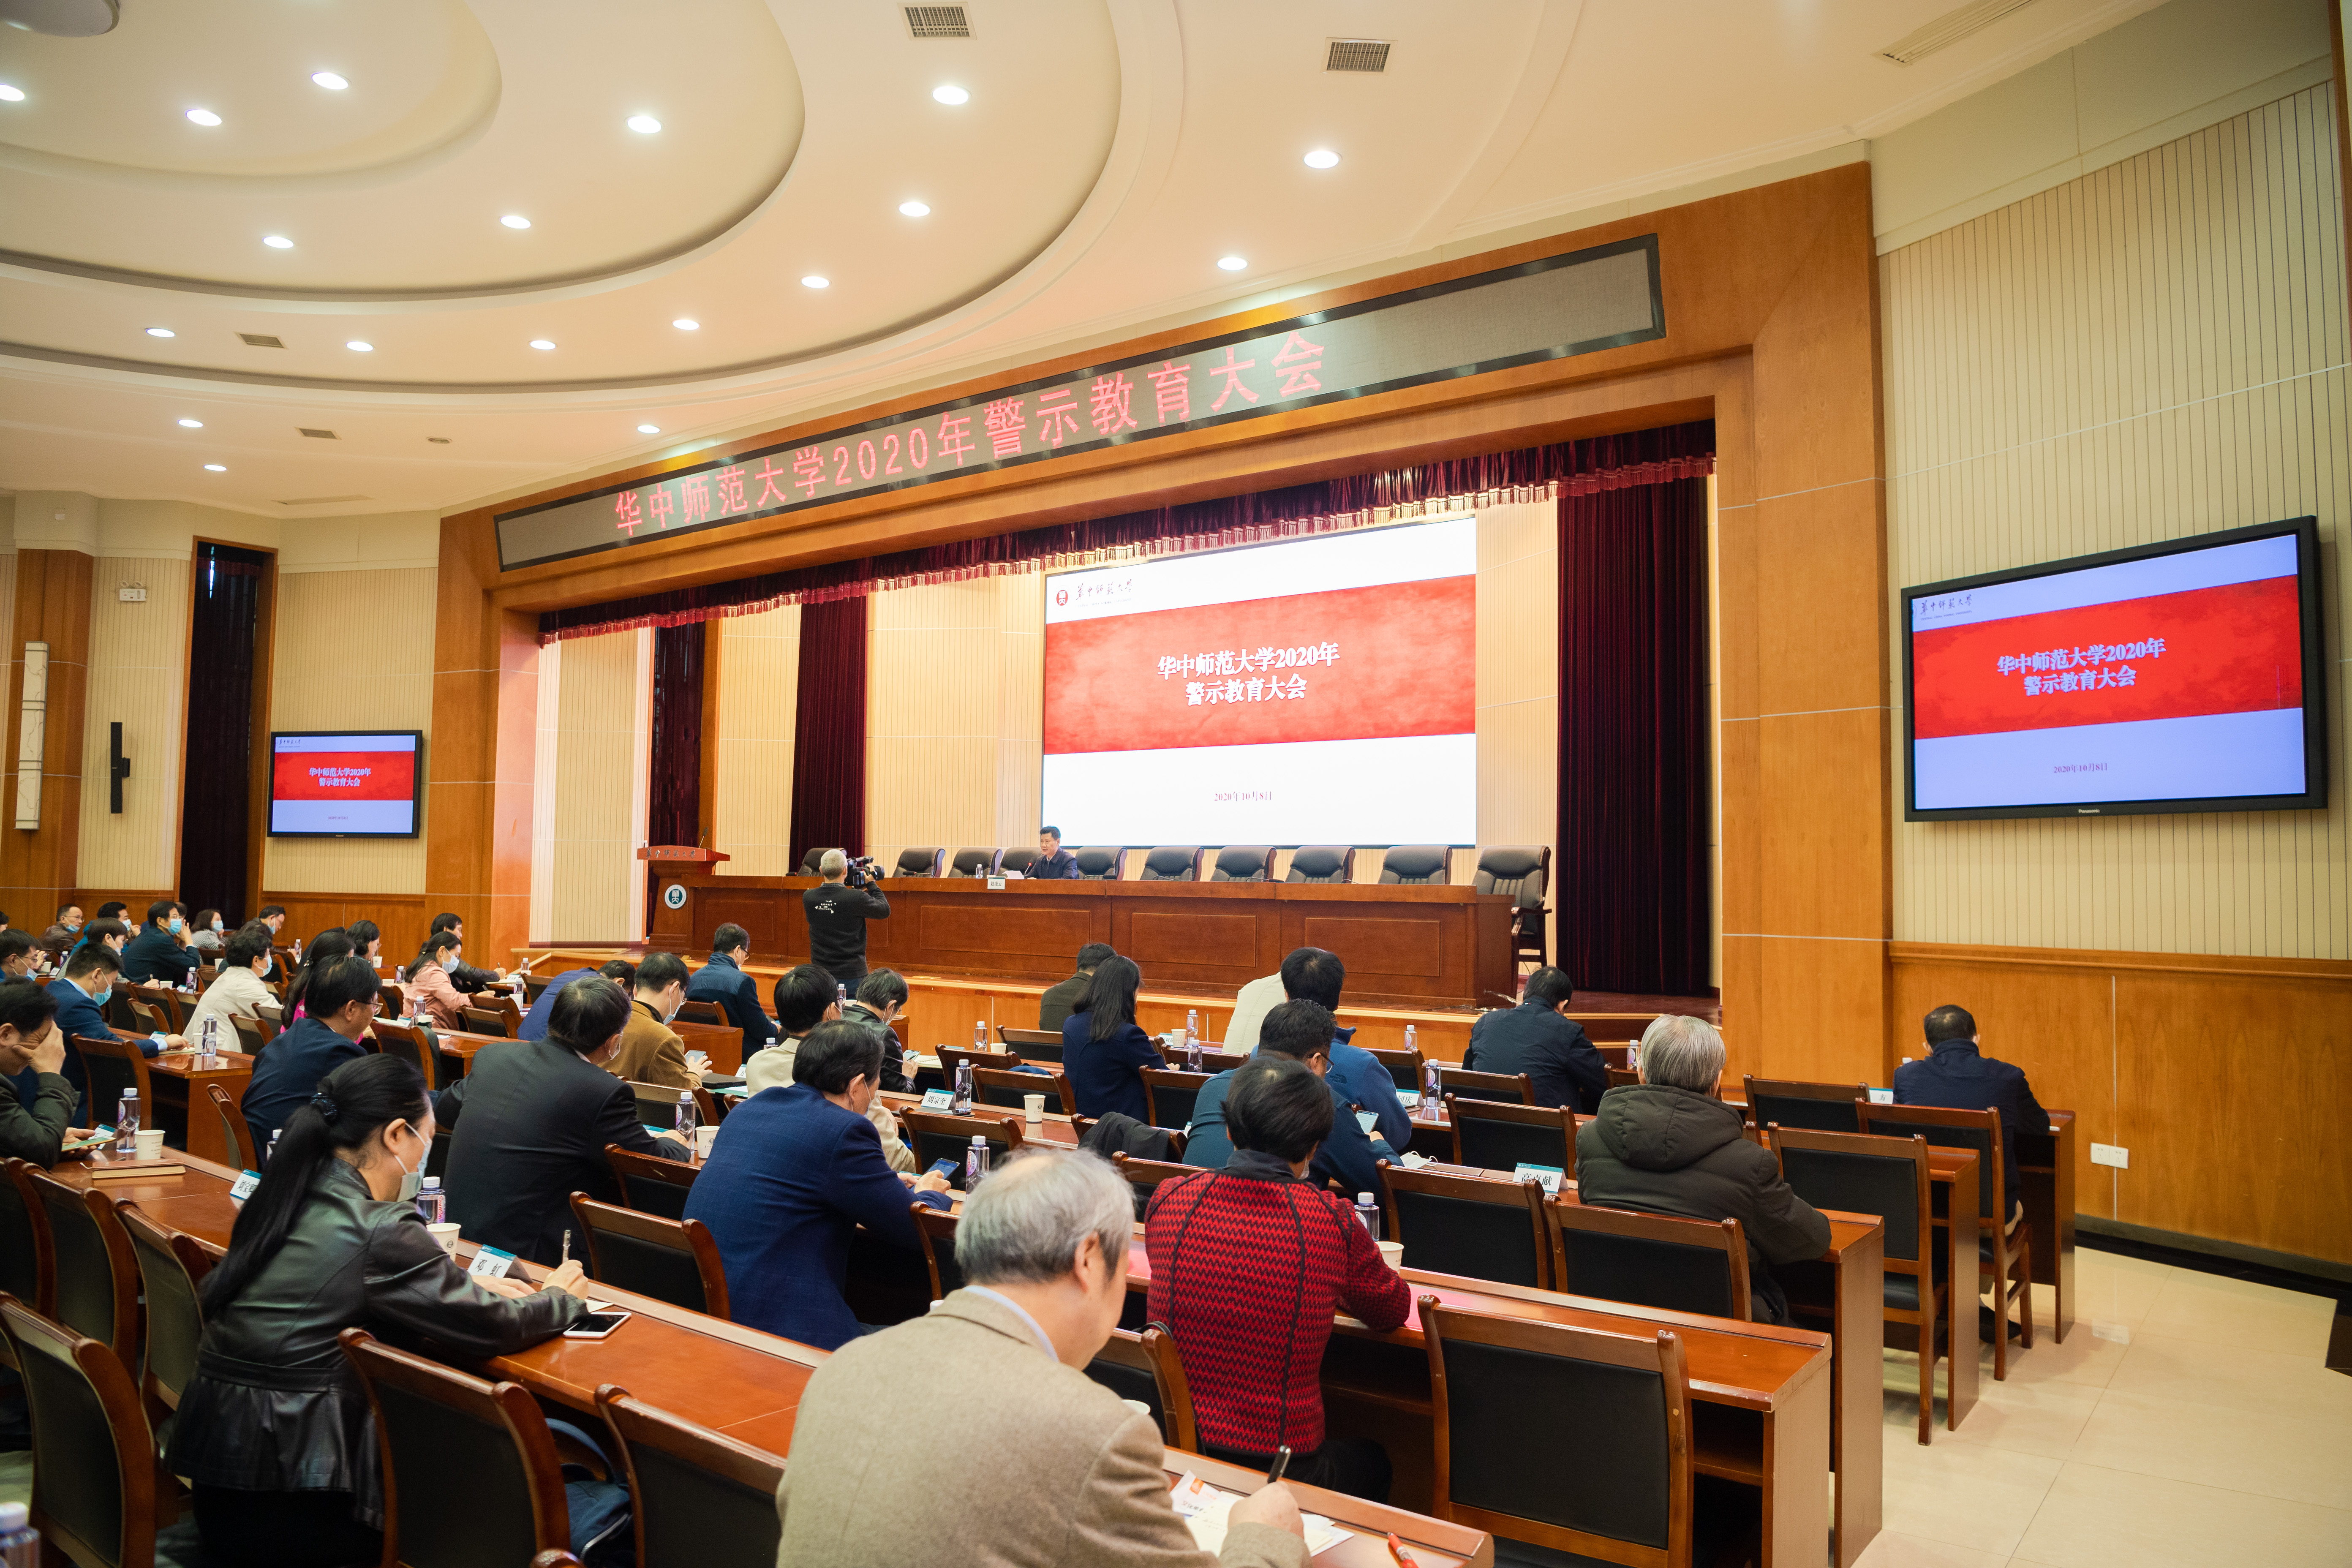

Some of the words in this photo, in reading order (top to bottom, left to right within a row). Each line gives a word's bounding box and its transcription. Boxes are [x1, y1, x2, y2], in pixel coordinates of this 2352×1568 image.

[615, 331, 1324, 536] 华中师范大学2020年警示教育大会
[1157, 641, 1340, 680] 华中师范大学2020年
[1997, 637, 2167, 676] 华中师范大学2020年
[1185, 673, 1307, 706] 警示教育大会
[2023, 664, 2137, 697] 警示教育大会
[309, 767, 371, 777] 华中师范大学2020年
[318, 777, 361, 787] 警示教育大会
[2053, 762, 2107, 773] 2020年10月8日
[927, 1095, 947, 1105] 周宗奎
